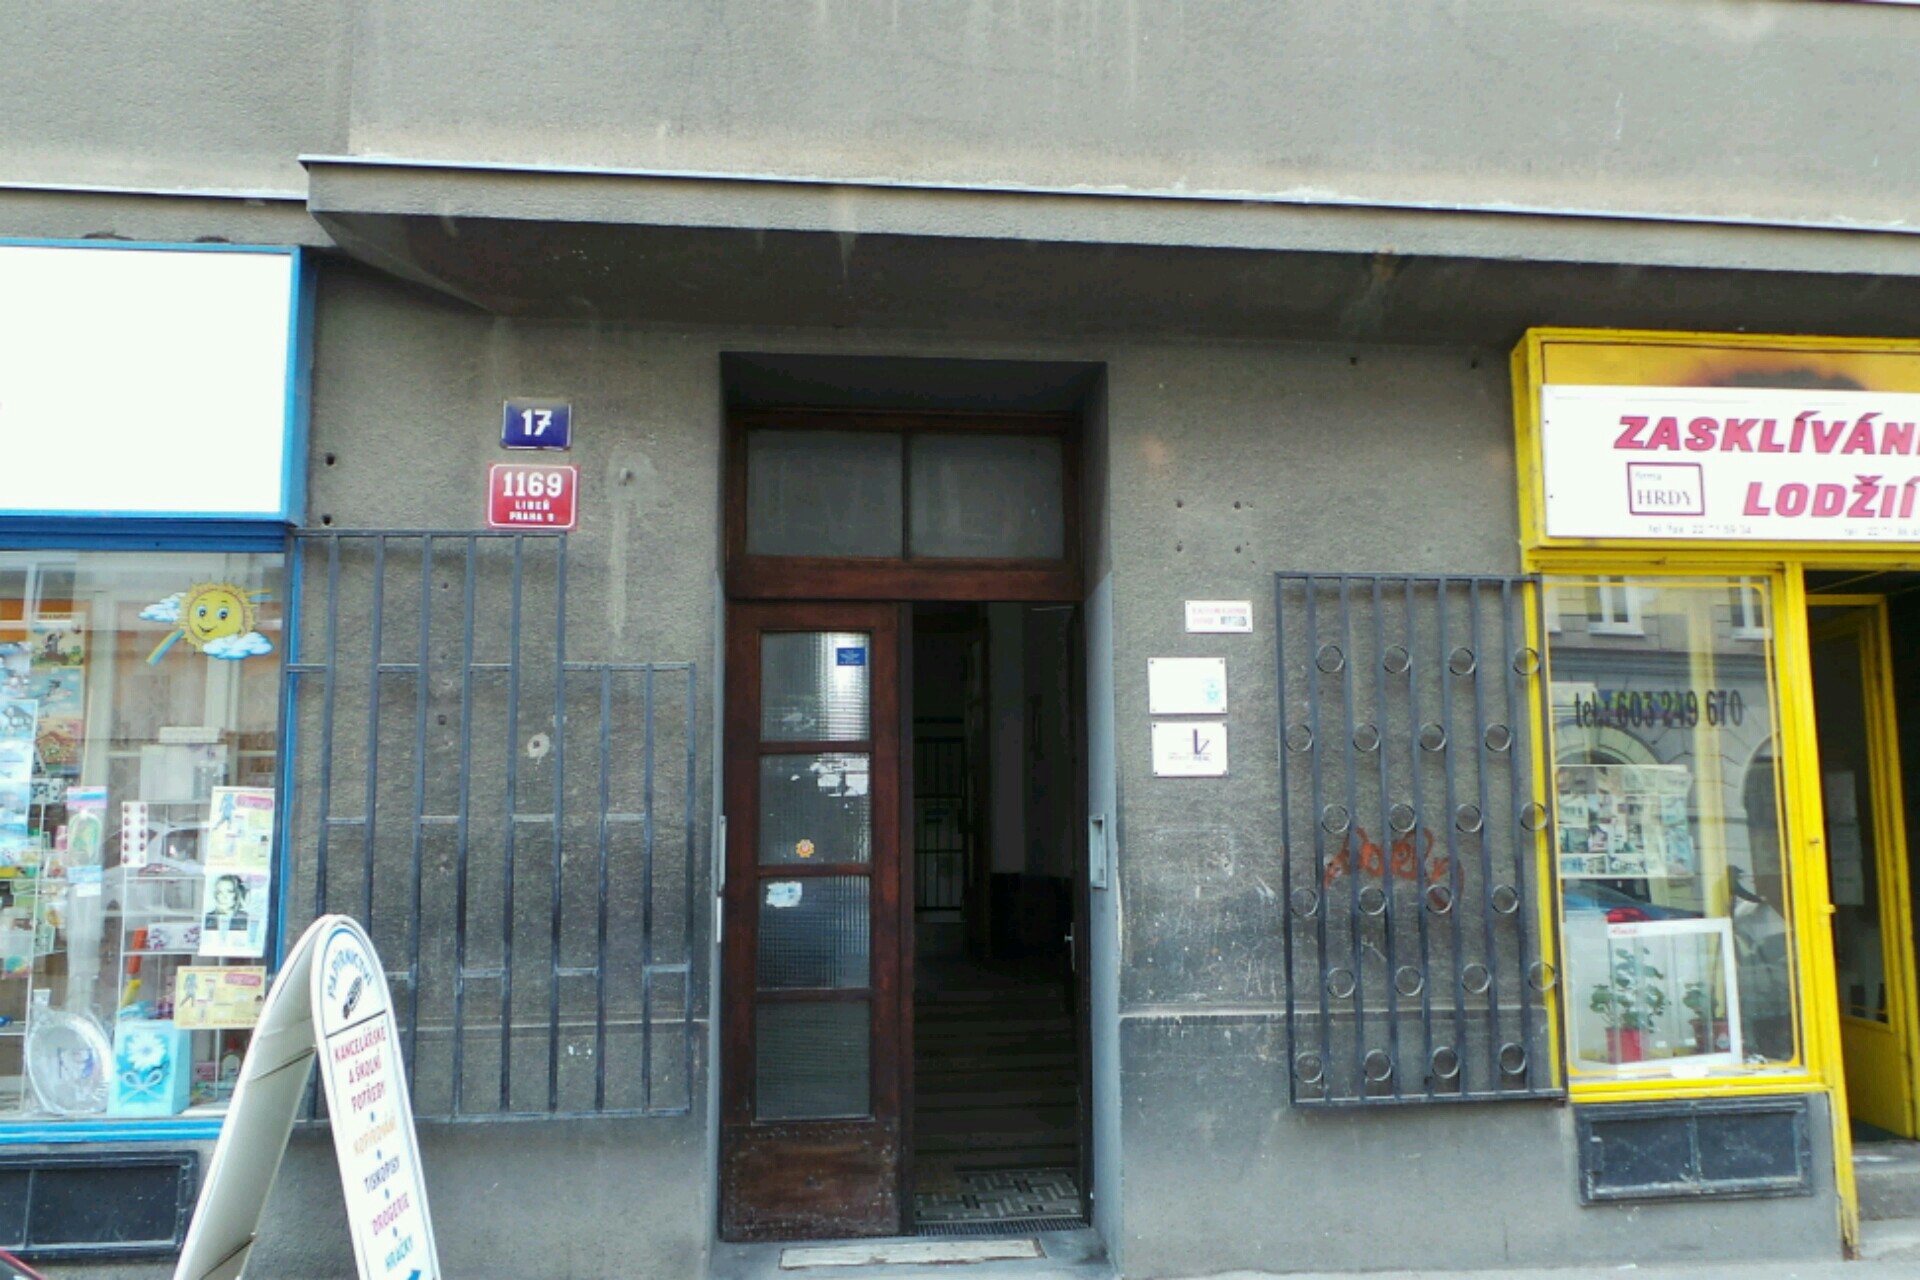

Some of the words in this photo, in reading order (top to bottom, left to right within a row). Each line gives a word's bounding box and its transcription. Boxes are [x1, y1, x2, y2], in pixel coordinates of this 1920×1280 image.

[521, 408, 552, 436] 17
[1613, 410, 1920, 455] ZASKLÍVÁN
[503, 471, 563, 498] 1169
[509, 511, 544, 521] PRAHA
[1616, 691, 1654, 728] 603
[1661, 690, 1699, 728] 249
[371, 1192, 410, 1236] DROGERIE
